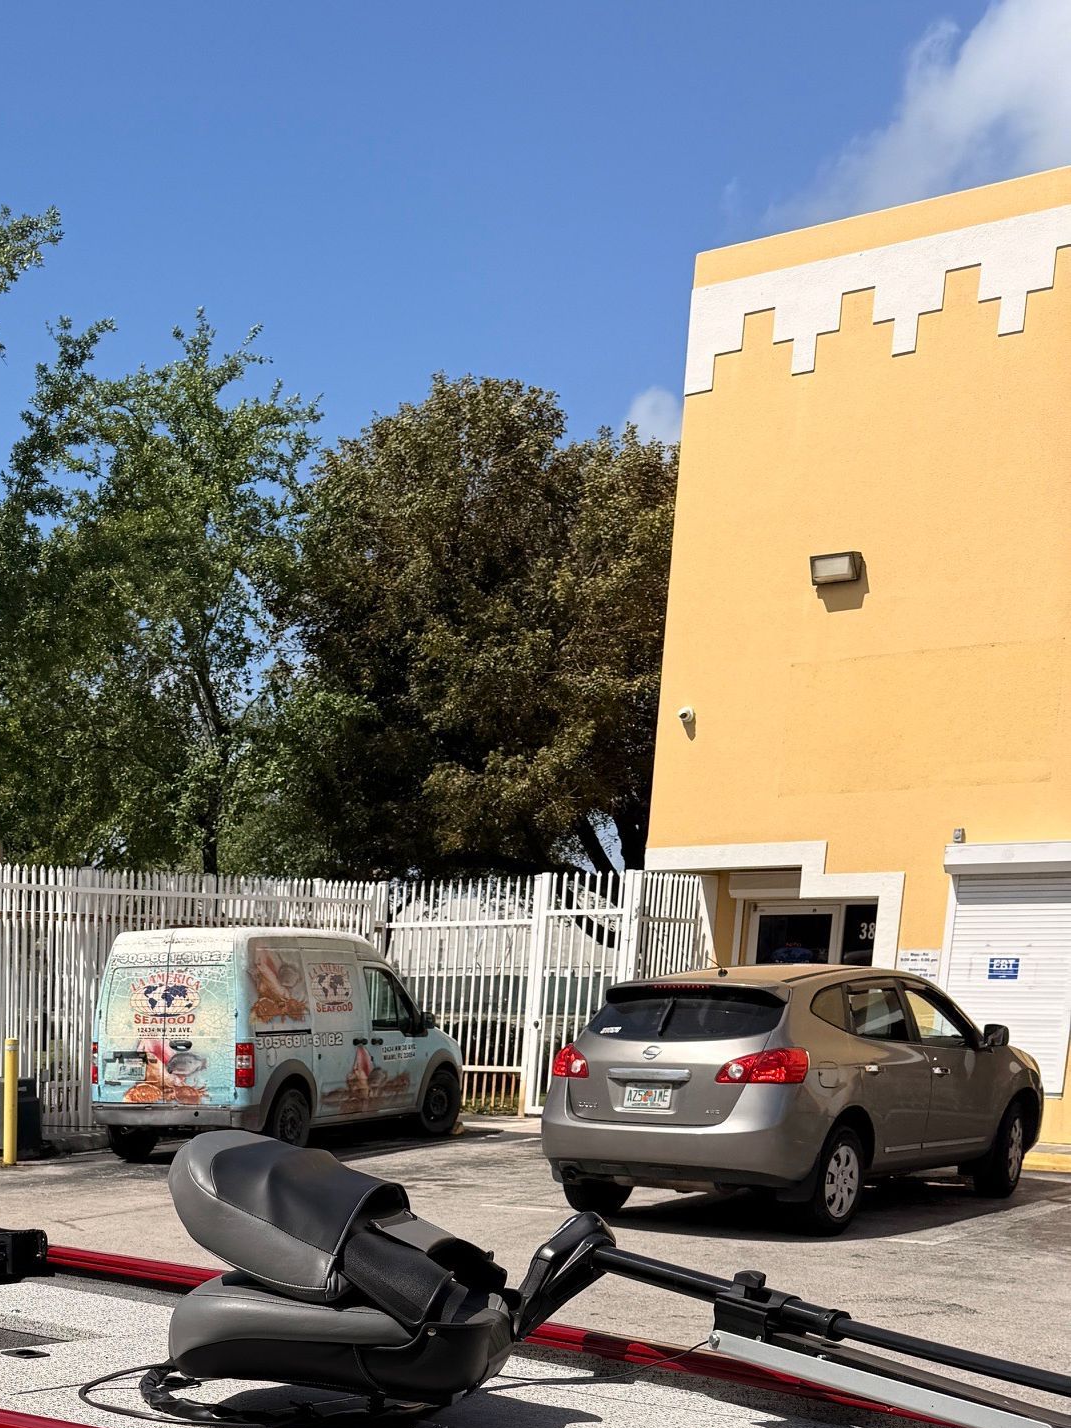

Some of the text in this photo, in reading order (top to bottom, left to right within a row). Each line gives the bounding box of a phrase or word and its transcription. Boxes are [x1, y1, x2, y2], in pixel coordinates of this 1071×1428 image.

[130, 972, 201, 992] LA AMERICA
[316, 1001, 353, 1013] SEAFOOD
[134, 1013, 196, 1025] SEAFOOD
[256, 1032, 343, 1050] 305-681-6182
